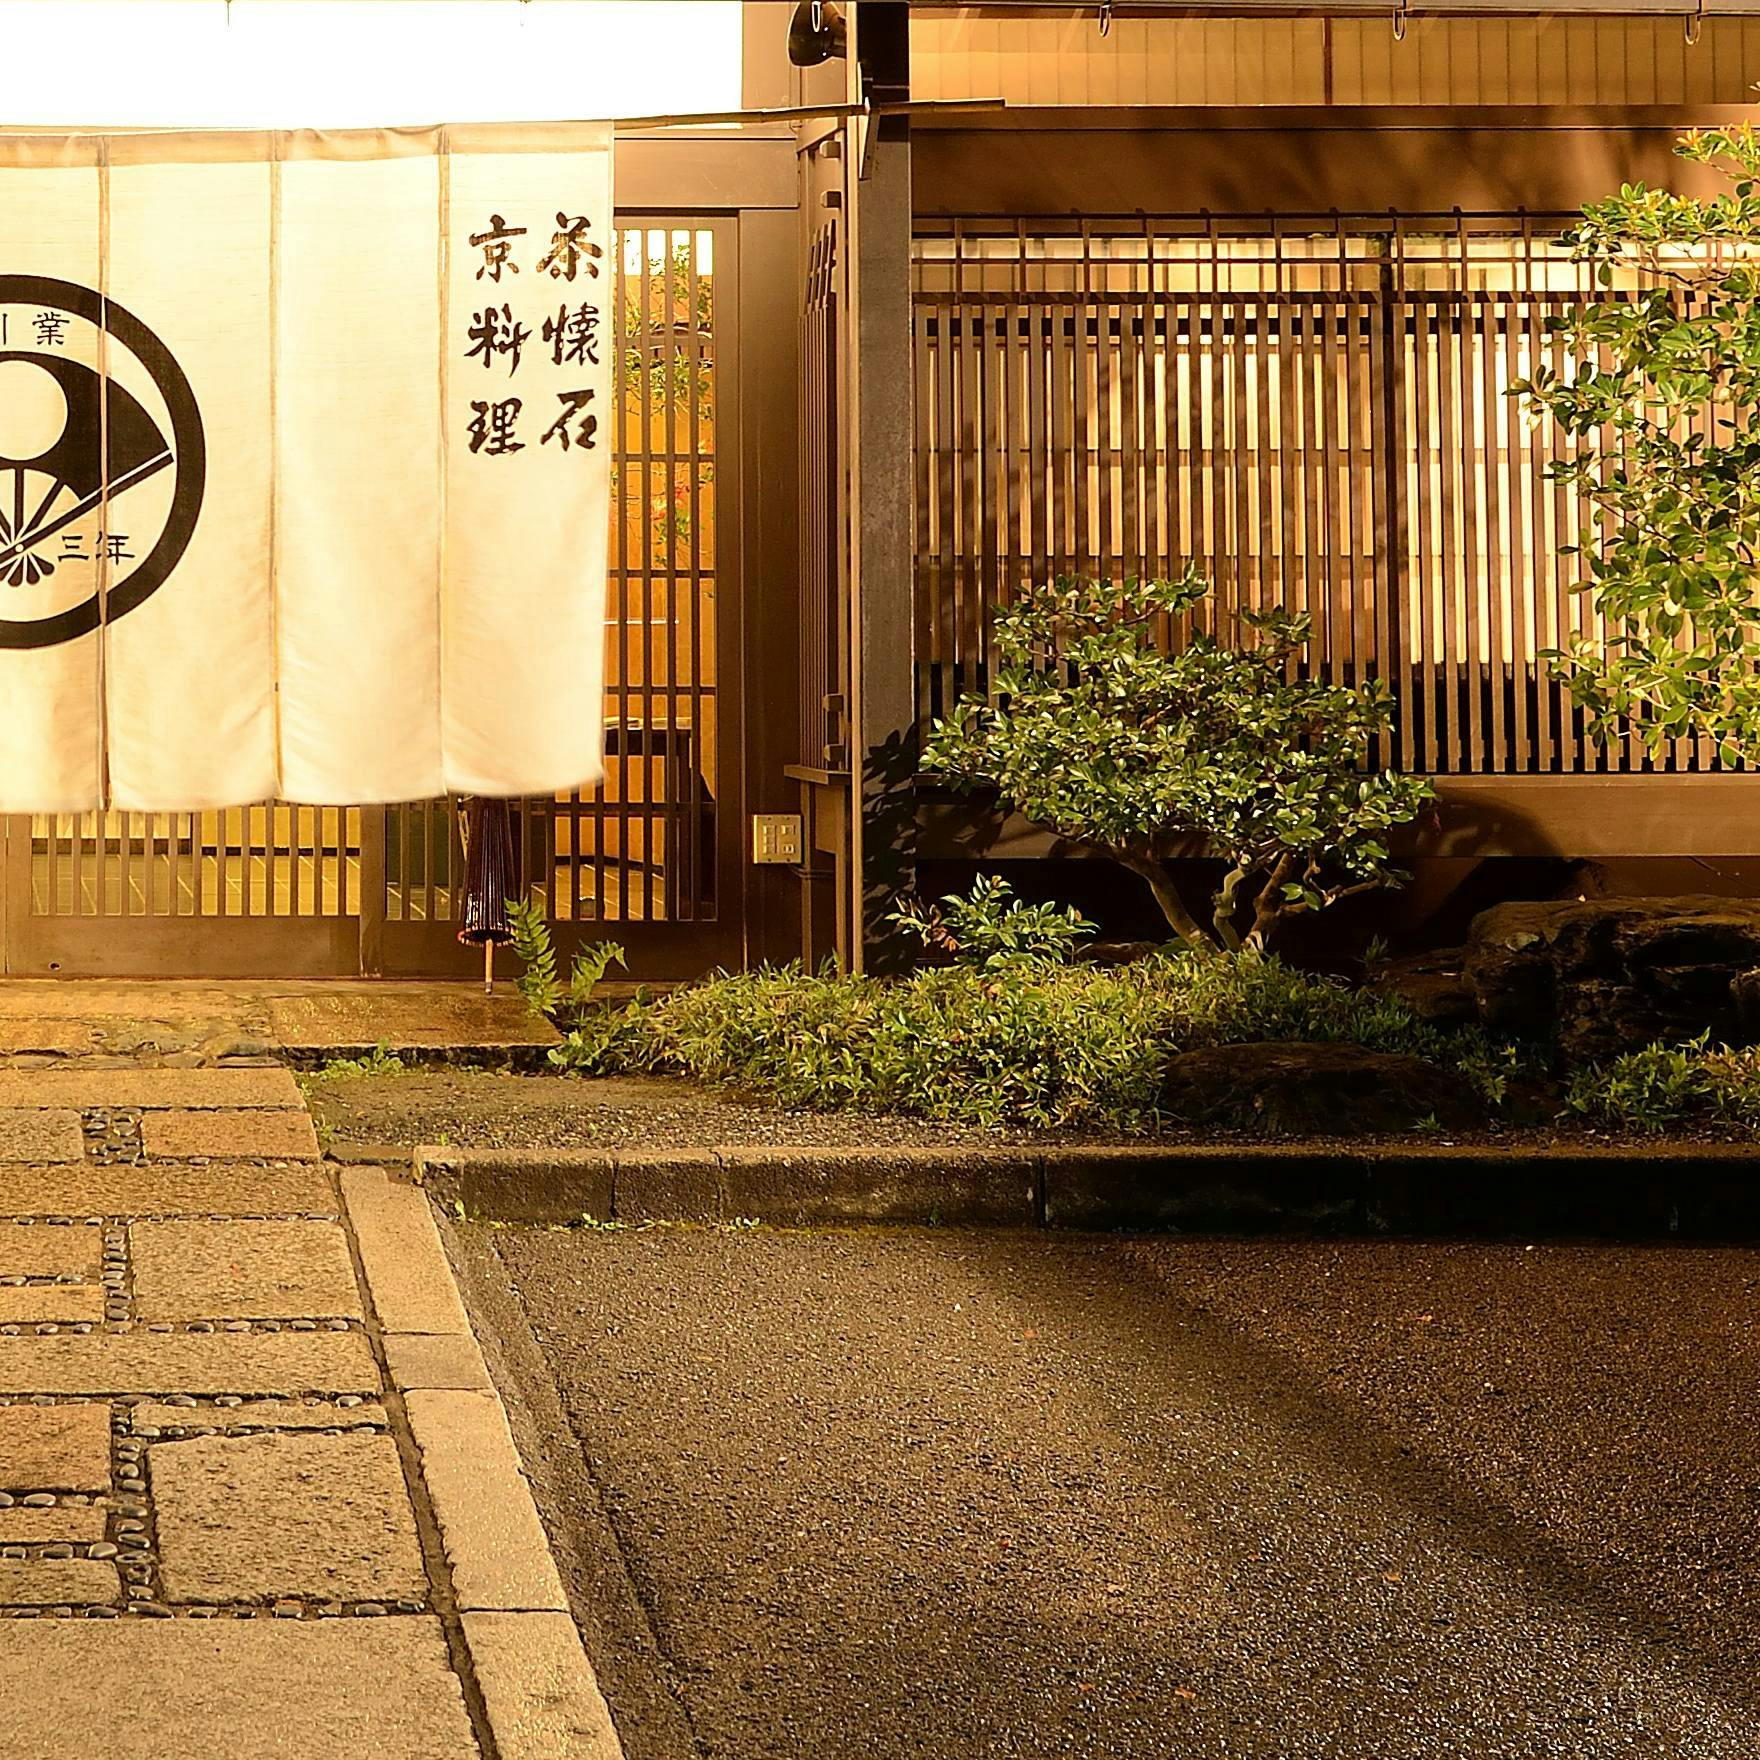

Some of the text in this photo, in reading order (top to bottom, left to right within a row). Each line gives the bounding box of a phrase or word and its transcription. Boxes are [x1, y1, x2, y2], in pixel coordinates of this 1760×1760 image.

[465, 214, 533, 456] 京料理
[57, 531, 136, 566] 三年
